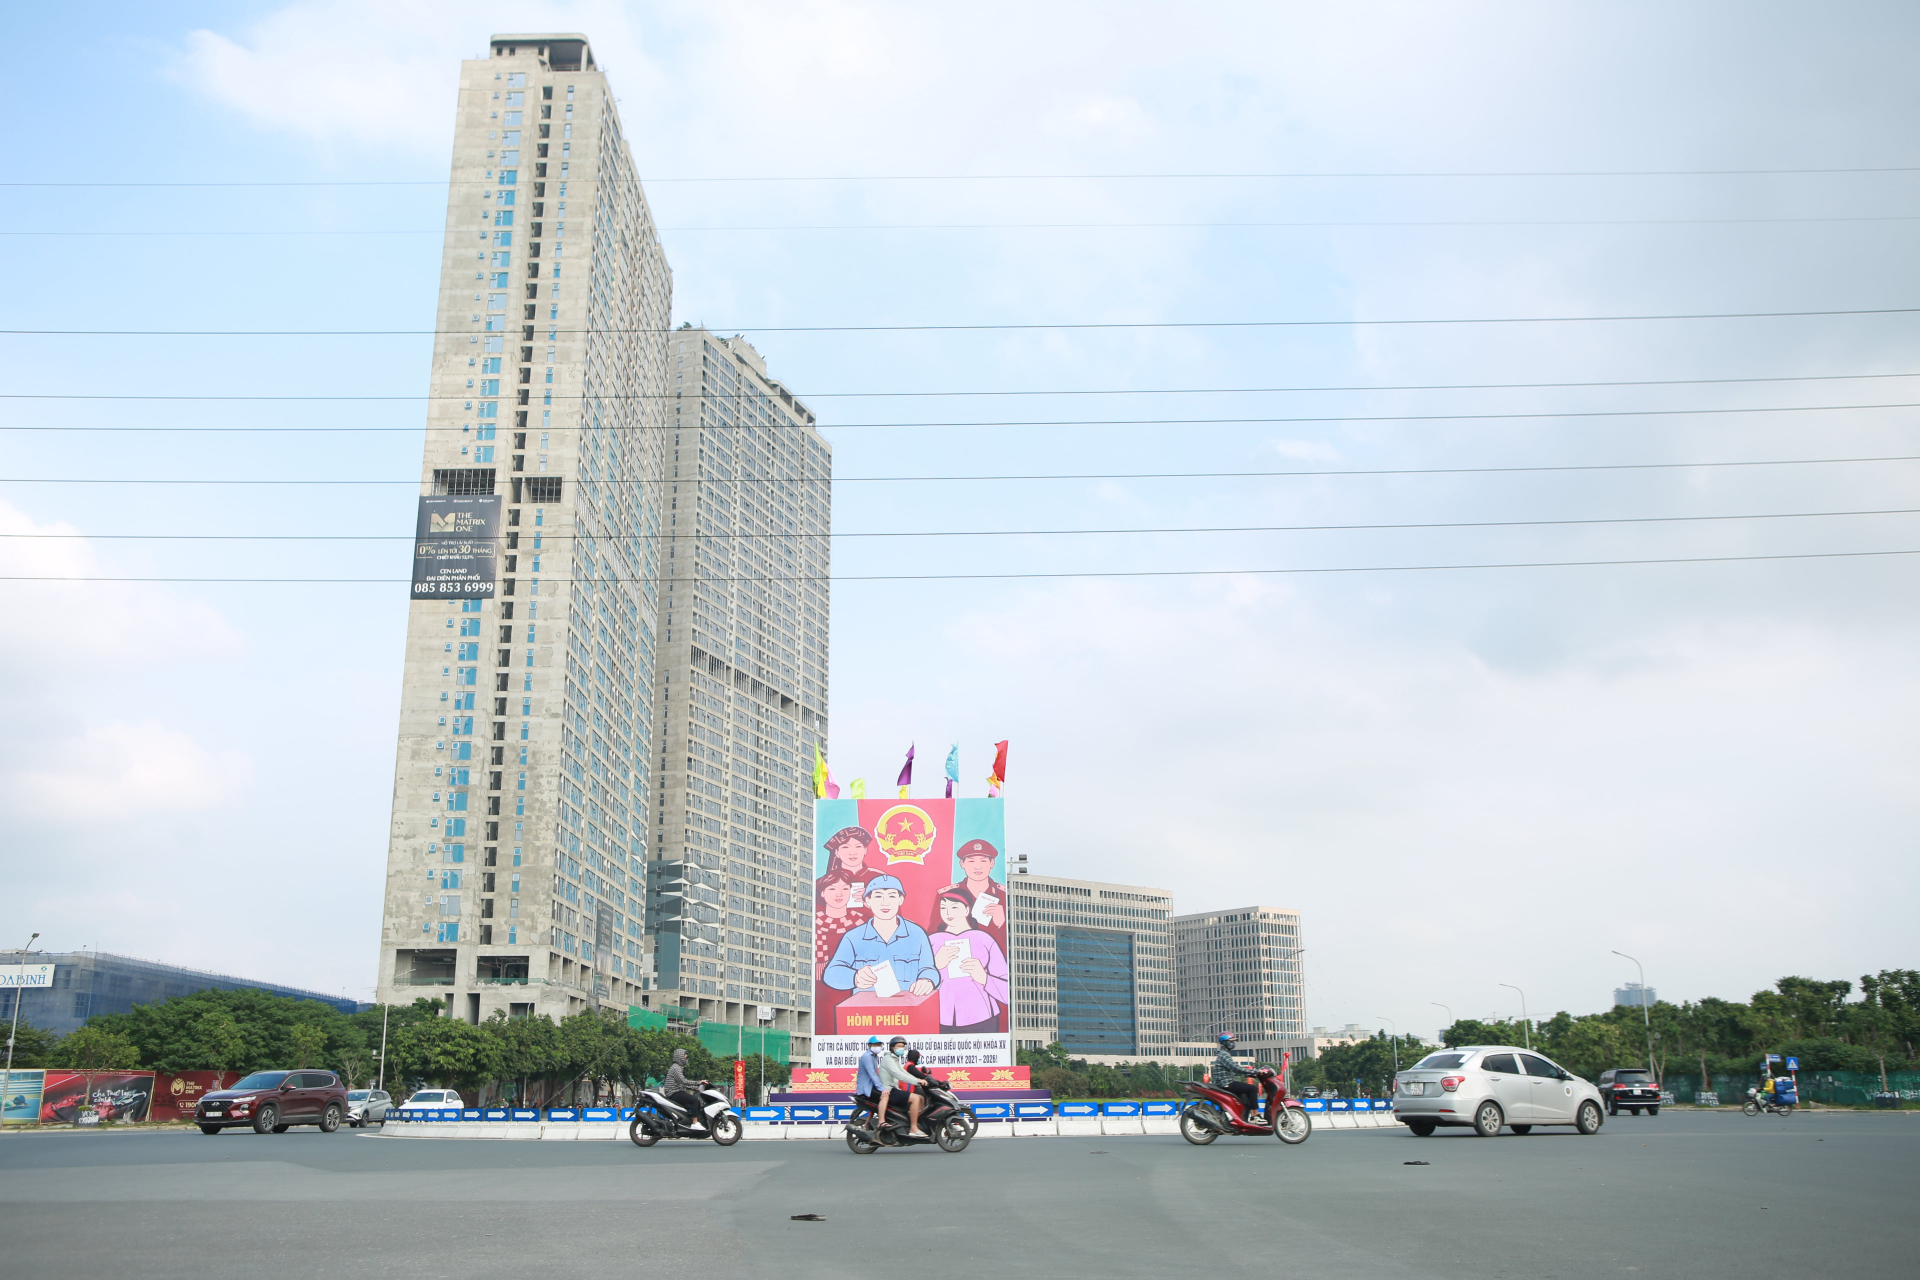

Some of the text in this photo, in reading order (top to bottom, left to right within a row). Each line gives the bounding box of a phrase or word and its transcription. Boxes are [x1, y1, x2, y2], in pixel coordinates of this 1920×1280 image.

[420, 545, 436, 554] 0%
[458, 544, 471, 554] 30
[472, 546, 492, 554] THÁNG
[414, 582, 493, 593] 085 853 6999
[847, 1011, 909, 1026] HÒM PHIẾU
[958, 1038, 971, 1051] QUỐC
[973, 1039, 982, 1051] HỘI
[984, 1039, 997, 1049] KHÓA
[826, 1055, 832, 1065] VÀ
[926, 1052, 936, 1064] CẤP
[938, 1054, 955, 1066] NHIỆM
[957, 1054, 964, 1064] KỲ
[965, 1055, 977, 1064] 2021
